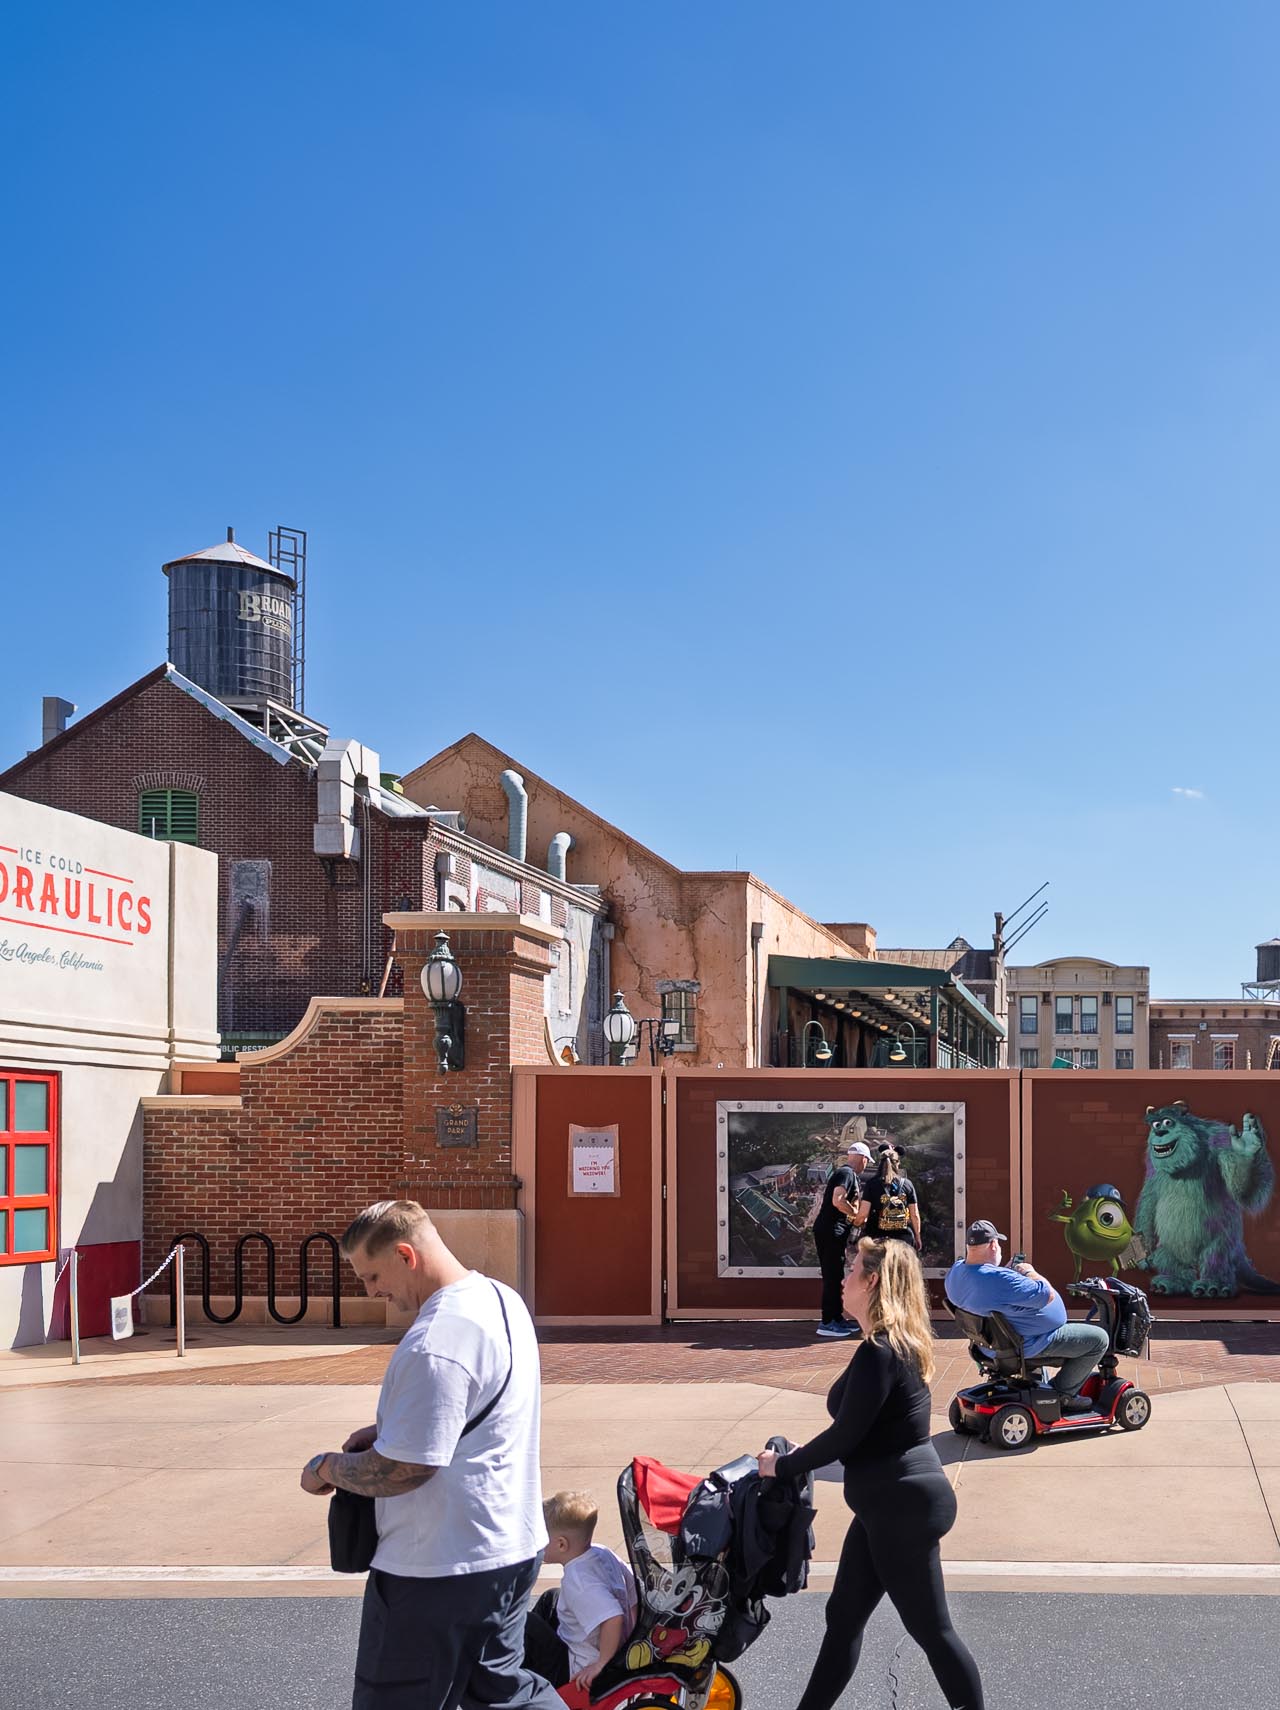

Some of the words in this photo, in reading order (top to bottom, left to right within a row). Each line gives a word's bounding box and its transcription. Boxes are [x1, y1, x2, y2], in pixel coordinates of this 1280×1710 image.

[20, 847, 42, 864] ICE
[50, 855, 83, 874] COLD
[59, 950, 104, 972] California
[444, 1119, 469, 1127] GRAND
[447, 1127, 465, 1135] PARK
